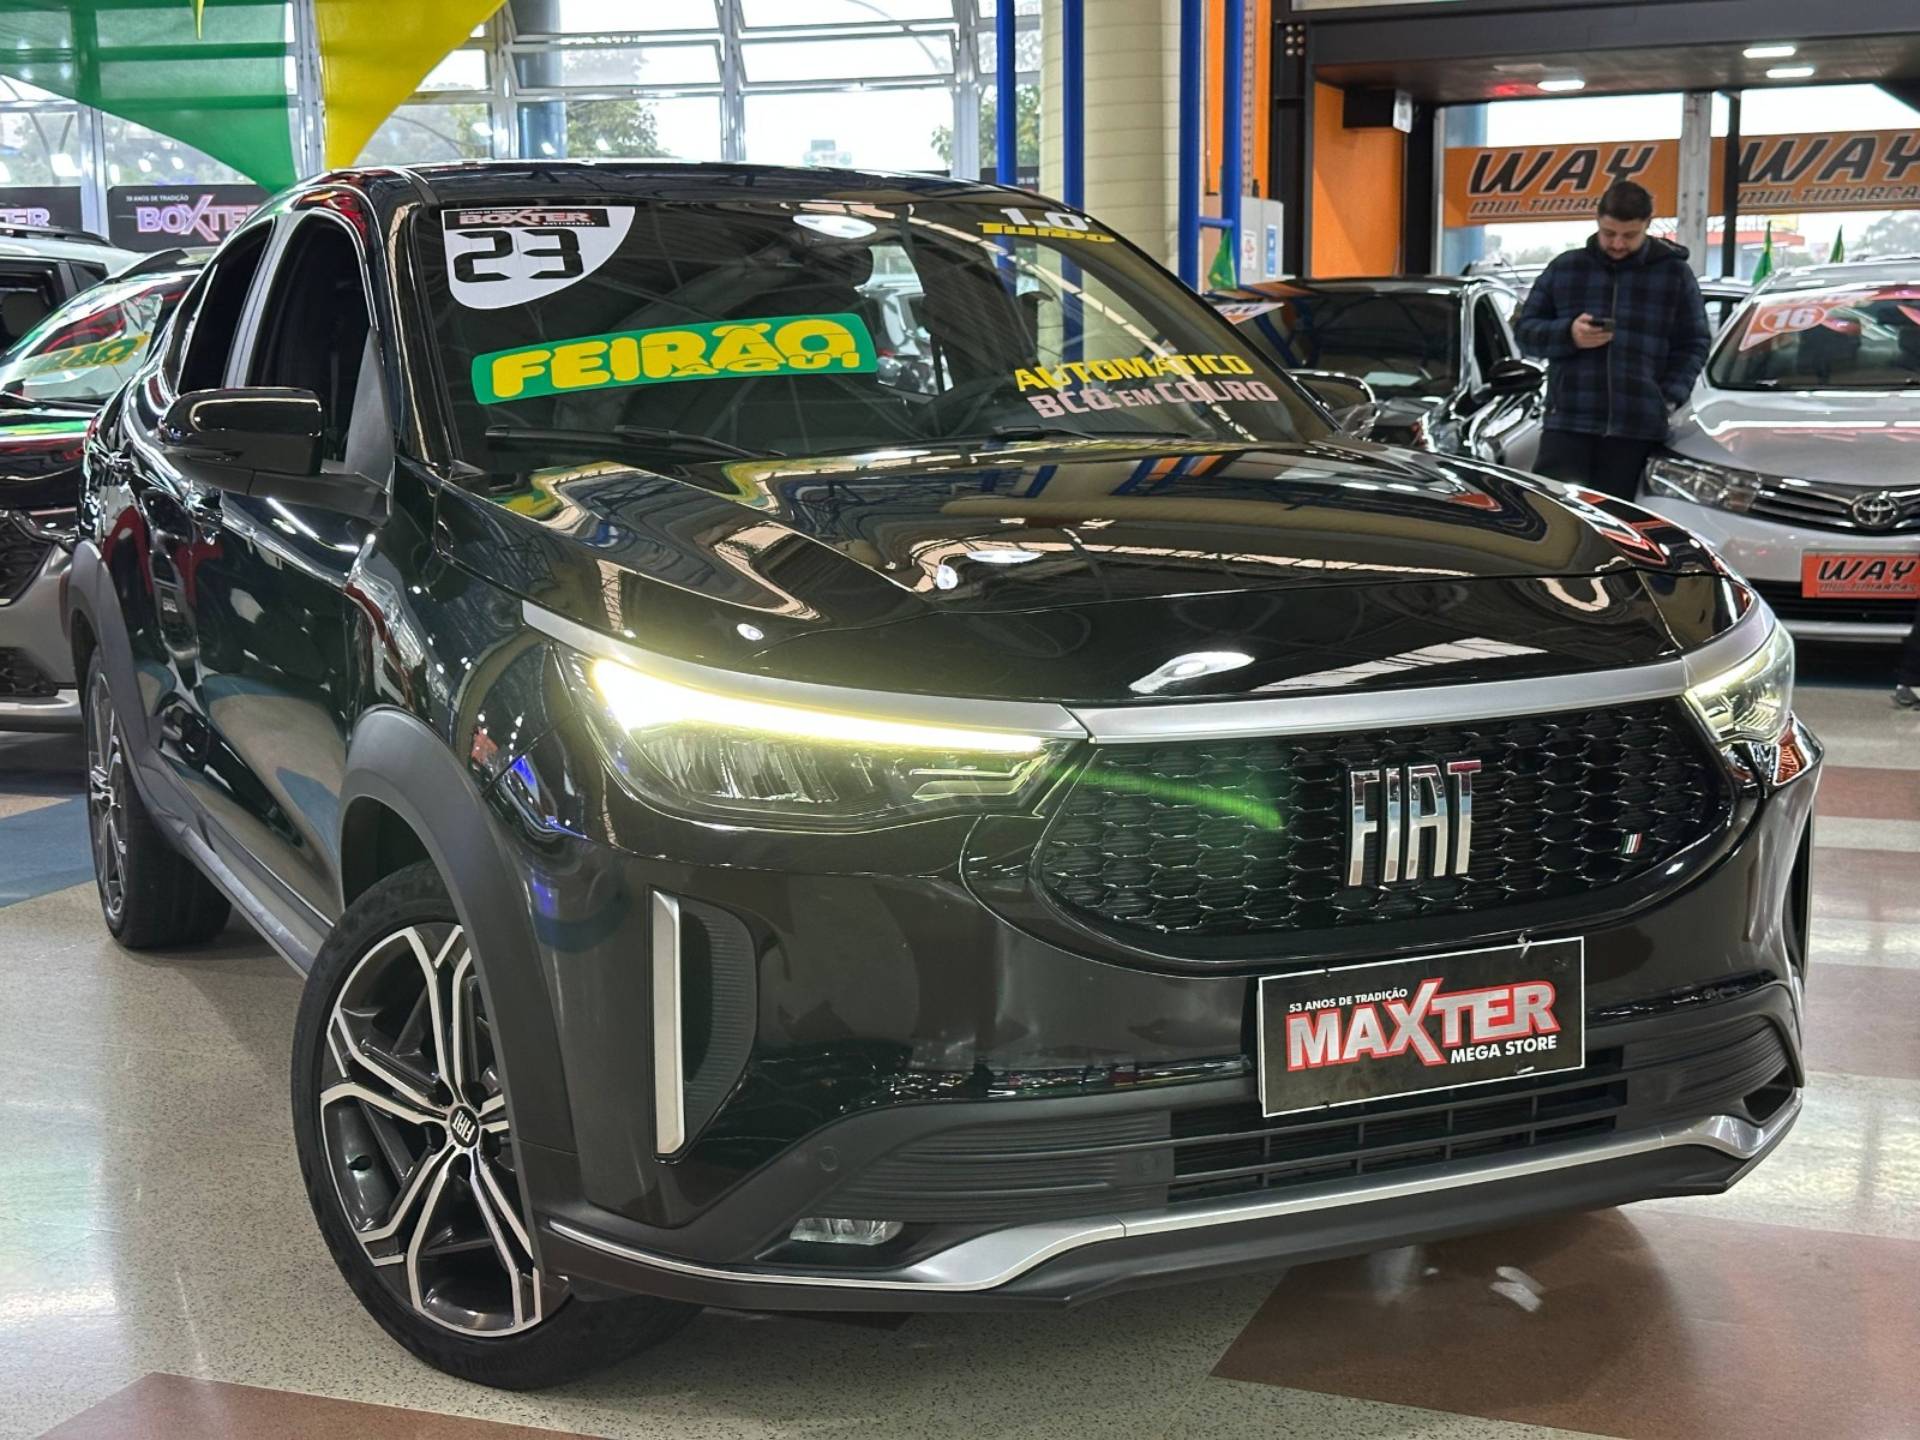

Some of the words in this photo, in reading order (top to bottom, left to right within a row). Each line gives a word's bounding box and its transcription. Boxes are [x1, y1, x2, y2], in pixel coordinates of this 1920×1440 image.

[1468, 145, 1656, 196] WAY
[1739, 135, 1920, 184] WAY
[1738, 185, 1920, 203] MULTIMARCA
[136, 194, 260, 242] BOXTE
[459, 208, 592, 226] BOXTER
[1000, 207, 1089, 231] 1.0
[453, 227, 584, 283] 23
[1773, 309, 1815, 331] 16
[492, 319, 855, 398] FEIRÃO
[1116, 389, 1162, 407] EM
[1154, 381, 1280, 405] COURO
[1818, 559, 1918, 581] WAY
[1348, 759, 1482, 887] FIAT
[1288, 1002, 1303, 1014] 53
[1304, 998, 1336, 1012] ANOS
[1338, 995, 1353, 1006] DE
[1354, 987, 1408, 1004] TRADIÇÃO
[1286, 977, 1561, 1072] MAXTER
[1450, 1044, 1502, 1064] MEGA
[1504, 1034, 1558, 1056] STORE
[451, 1110, 476, 1143] FIAT
